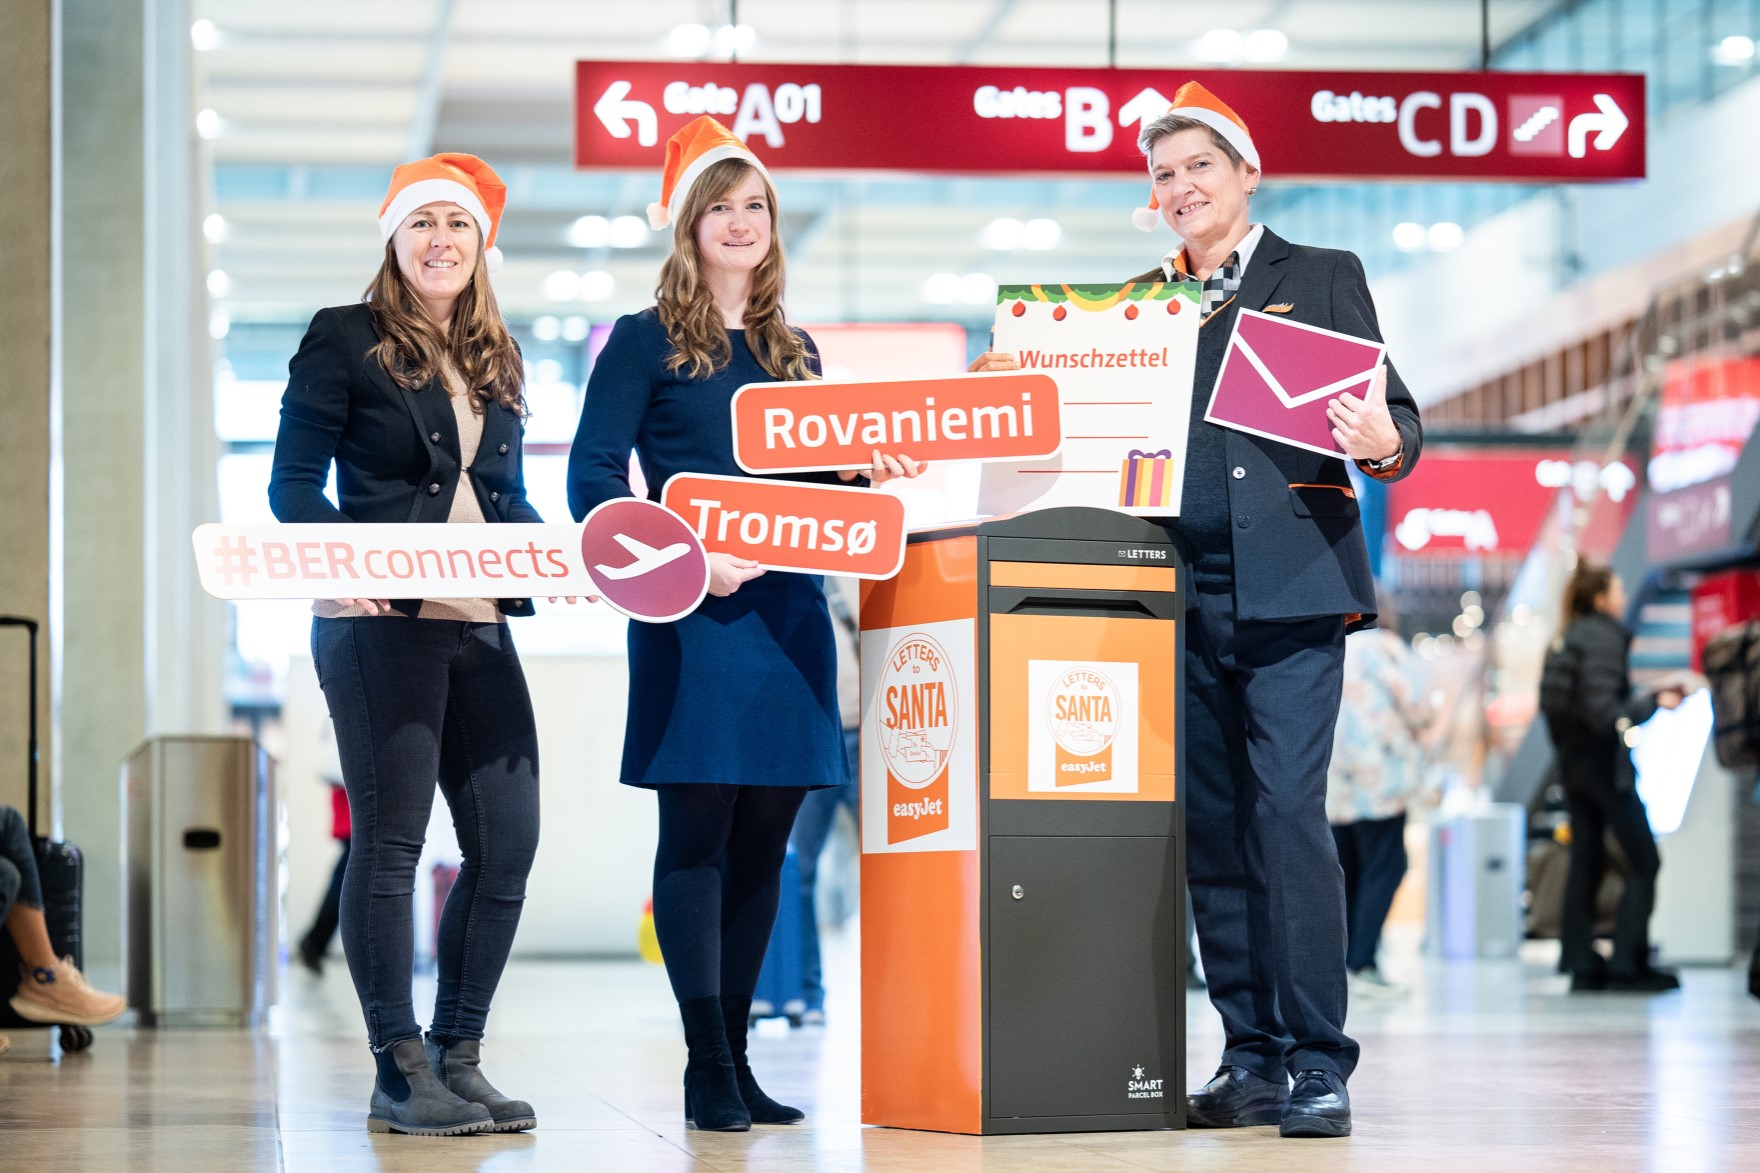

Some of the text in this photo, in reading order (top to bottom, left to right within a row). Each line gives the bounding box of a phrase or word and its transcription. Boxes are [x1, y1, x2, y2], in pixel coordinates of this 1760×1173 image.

[664, 81, 738, 114] Gate
[1311, 90, 1397, 122] Gates
[973, 85, 1113, 152] Gates B
[1019, 347, 1168, 369] Wunschzettel
[764, 392, 1034, 449] Rovaniemi
[689, 498, 878, 558] Tromsø
[1127, 549, 1167, 560] LETTERS
[893, 643, 941, 673] LETTERS
[912, 665, 920, 674] to
[1062, 672, 1106, 691] LETTERS
[886, 681, 949, 730] SANTA
[1056, 694, 1112, 722] SANTA
[1060, 761, 1107, 775] easyJet
[893, 797, 943, 820] easyJet
[1128, 1079, 1164, 1091] SMART
